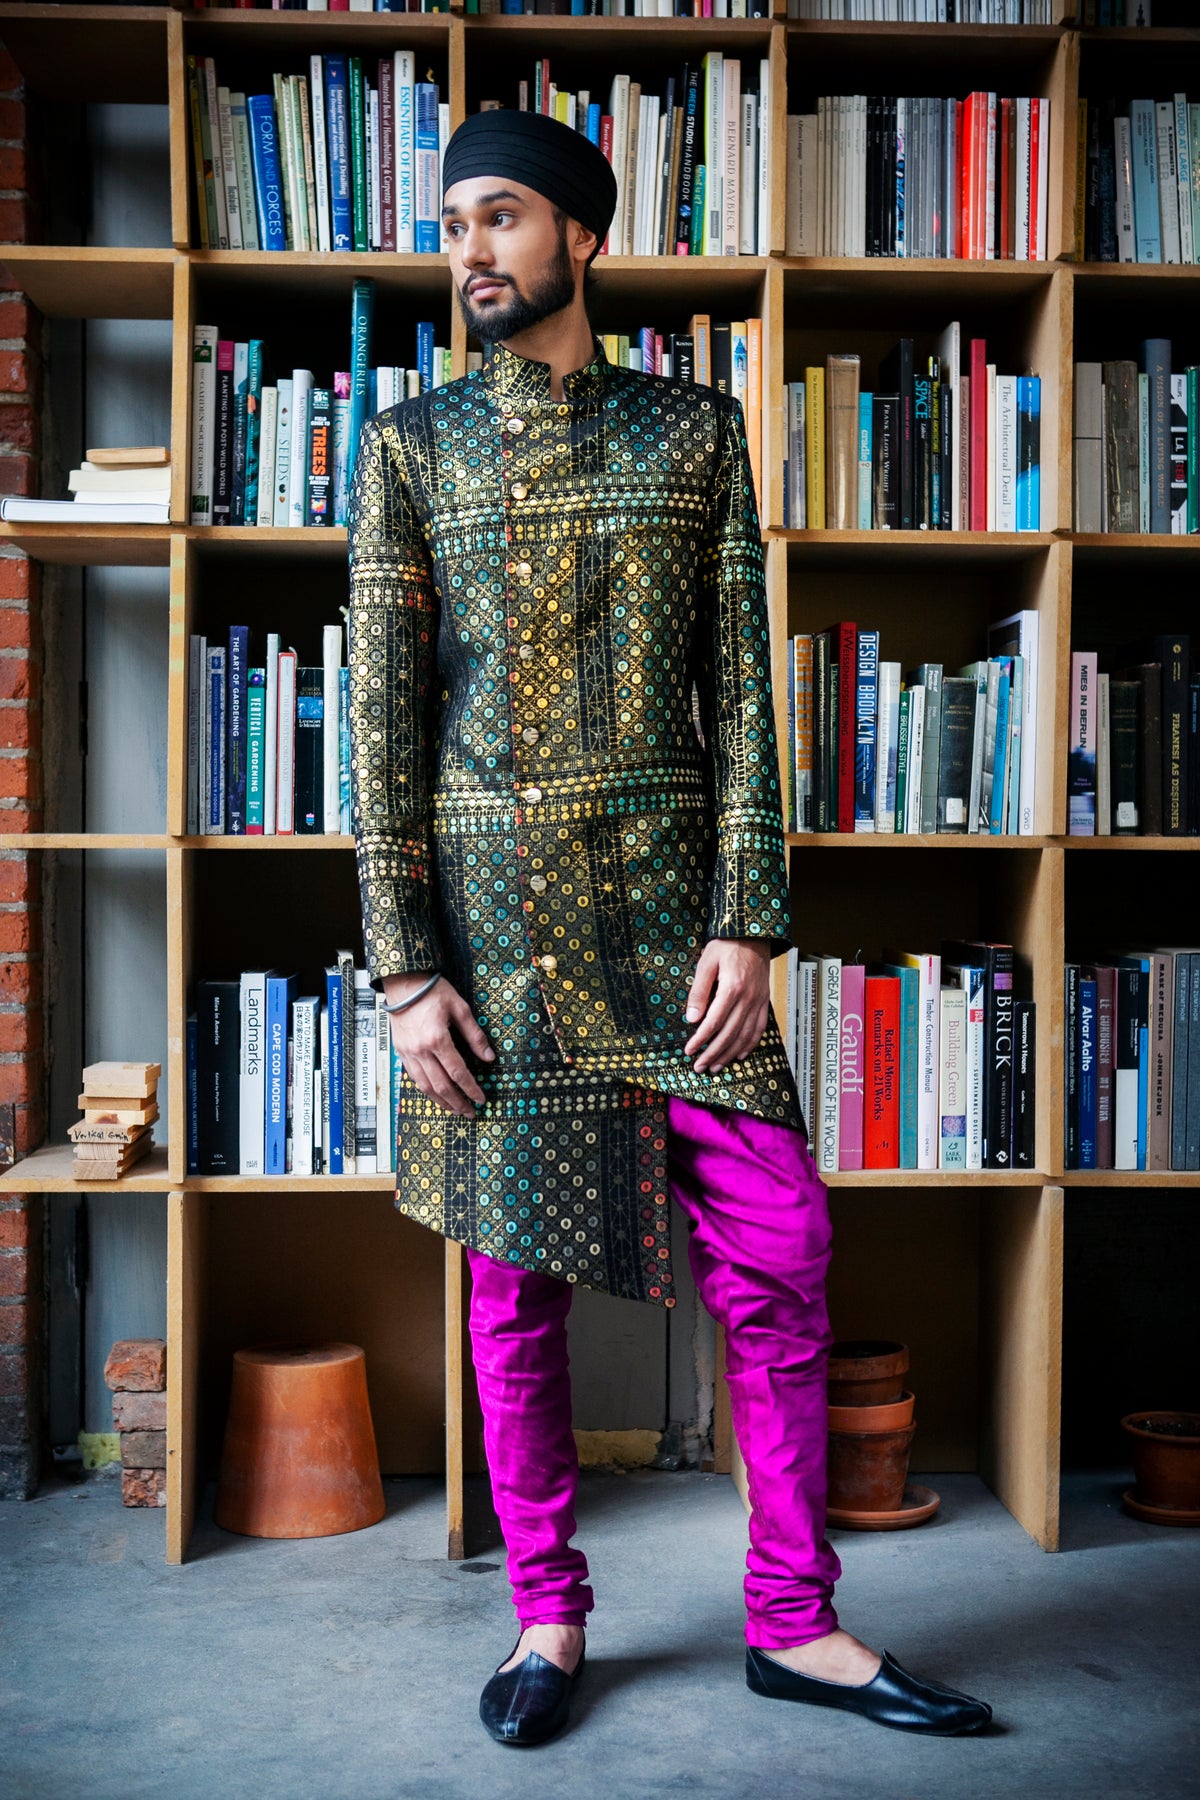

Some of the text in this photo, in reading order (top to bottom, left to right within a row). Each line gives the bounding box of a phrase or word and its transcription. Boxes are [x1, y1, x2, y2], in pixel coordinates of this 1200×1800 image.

[337, 115, 346, 157] Construction
[682, 72, 698, 200] THE GREEN STUDIO HANDBOOK
[1177, 102, 1186, 136] STUDIO
[400, 86, 410, 229] ESSENTIALS OF DRAFTING
[1178, 140, 1187, 150] AT
[260, 115, 281, 235] FORM AND FORCES
[338, 166, 348, 195] Detailing
[726, 121, 735, 231] BERNARD MAYBECK
[1179, 153, 1189, 182] LARGE
[384, 209, 392, 234] Blackburn
[356, 316, 368, 396] ORANGERIES
[221, 375, 229, 411] PLANTING
[915, 381, 928, 419] SPACE
[333, 405, 349, 449] Trees
[1157, 411, 1164, 423] OF
[196, 425, 205, 489] SOURCEBOOK
[219, 429, 227, 468] POST-WILD
[278, 439, 289, 481] SEEDS
[313, 427, 327, 475] TREES
[861, 429, 870, 460] cradle
[1001, 384, 1012, 505] The Architectural Detail
[1175, 438, 1184, 452] L.A.
[218, 470, 226, 496] WORLD
[859, 635, 876, 677] DESIGN
[233, 674, 240, 685] OF
[841, 636, 854, 736] WEISSENHOFSIEDLUNG
[232, 688, 240, 736] GARDENING
[857, 685, 875, 744] BROOKLYN
[996, 696, 1006, 755] Japan Modern
[1079, 665, 1088, 748] MIES IN BERLIN
[250, 698, 261, 792] VERTICAL GARDENING
[898, 715, 908, 774] BRUSSELS STYLE
[1170, 713, 1180, 829] PIRANESI AS DESIGNER
[303, 1006, 311, 1023] HOW
[331, 999, 339, 1023] Wijdeveld
[1158, 991, 1164, 1001] OF
[247, 988, 262, 1075] Landmarks
[303, 1024, 311, 1035] TO
[995, 996, 1011, 1070] BRICK
[1020, 1012, 1029, 1074] Tomorrow's Houses
[1081, 1006, 1092, 1038] Alvar
[303, 1037, 311, 1059] MAKE
[332, 1045, 340, 1077] Wittgenstein
[824, 965, 839, 1169] GREAT ARCHITECTURE OF THE WORLD
[841, 1013, 863, 1095] Gaudí
[874, 1009, 884, 1120] Remarks on 21 Works
[885, 1029, 895, 1101] Rafael Moneo
[924, 999, 934, 1093] Timber Construction Manual
[946, 1020, 960, 1106] Building Green
[1081, 1040, 1092, 1071] Aalto
[271, 1023, 281, 1123] CAPE COD MODERN
[303, 1068, 311, 1107] JAPANESE
[322, 1103, 330, 1123] COLOR
[74, 1130, 104, 1141] Vertical
